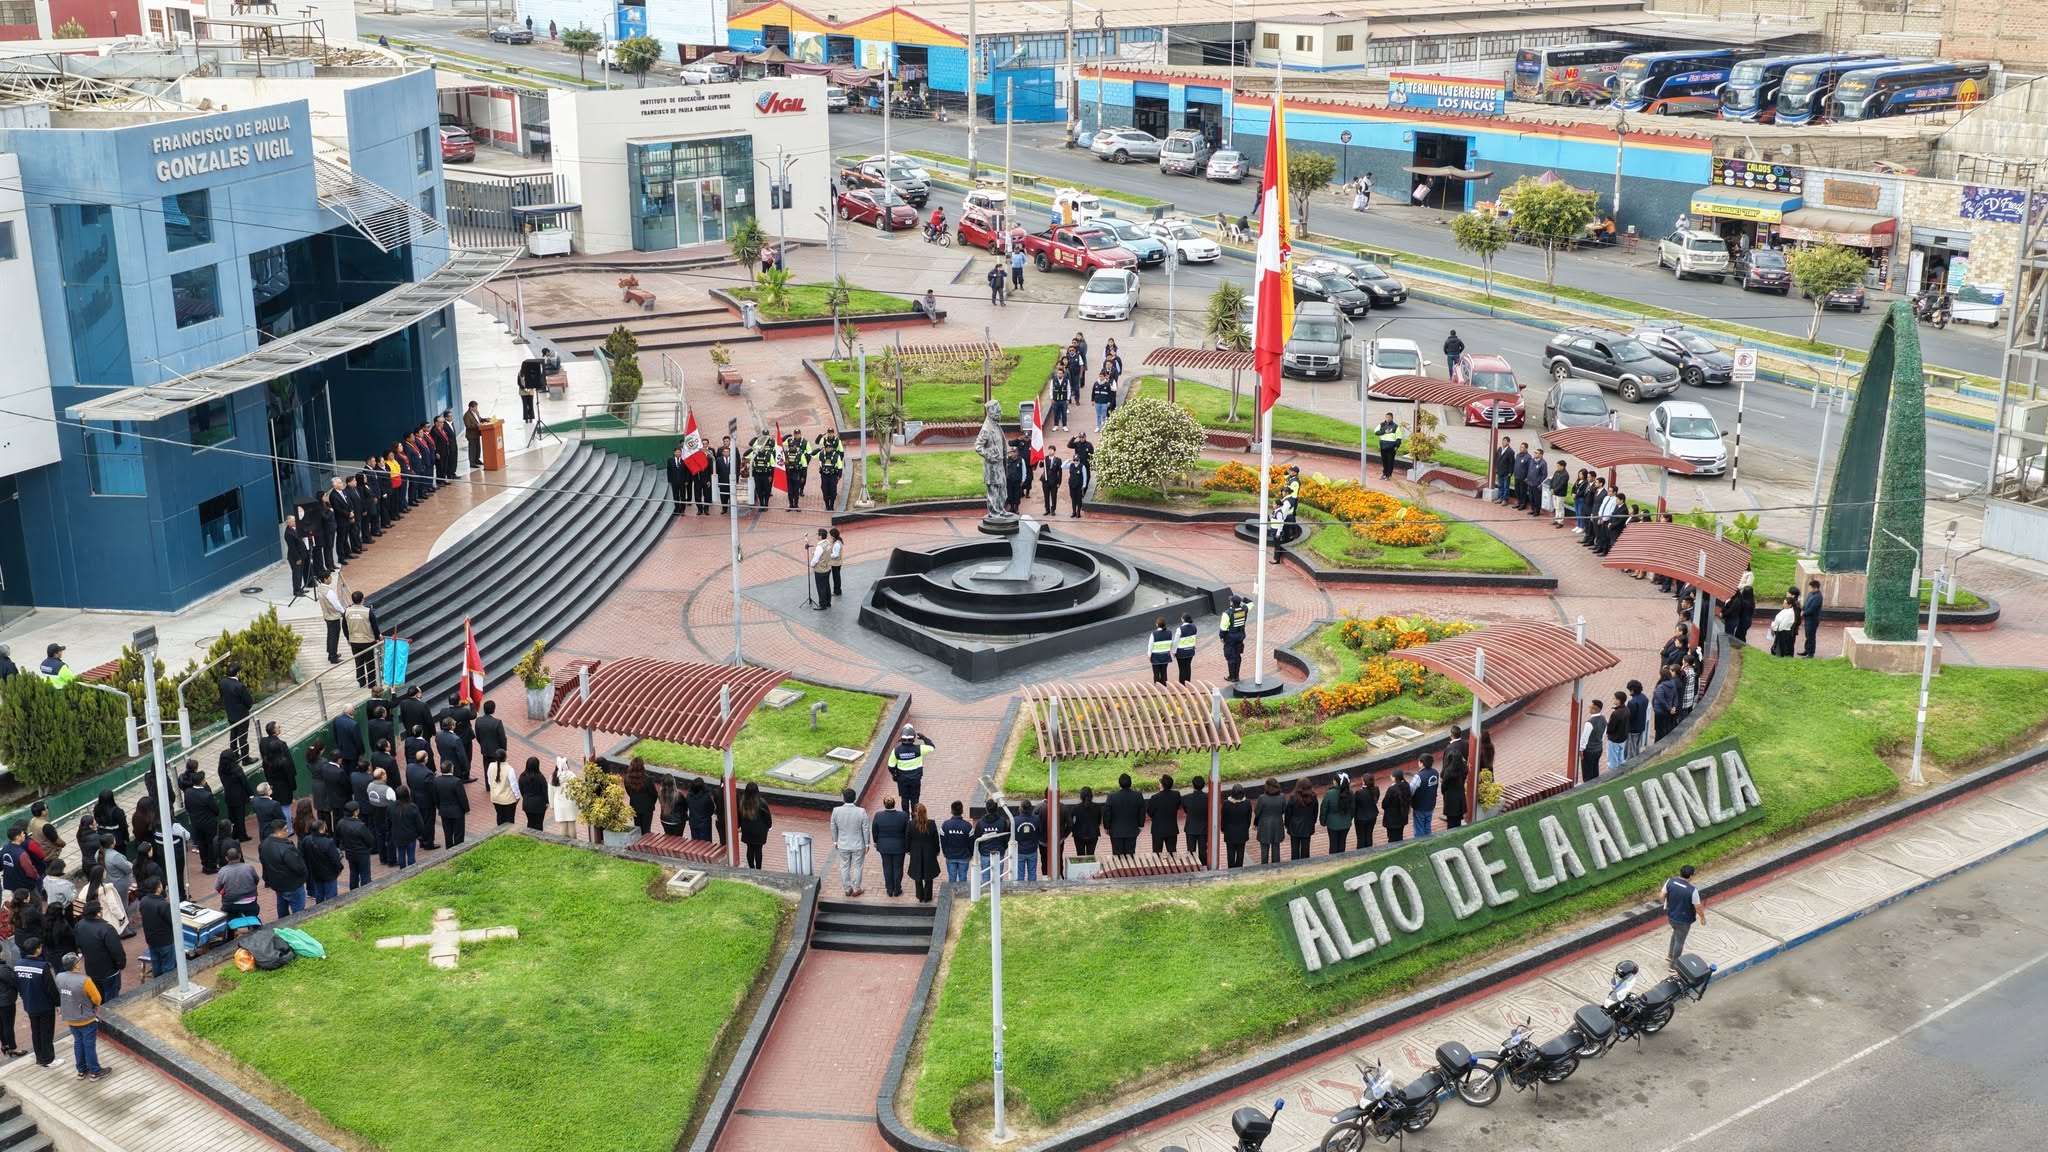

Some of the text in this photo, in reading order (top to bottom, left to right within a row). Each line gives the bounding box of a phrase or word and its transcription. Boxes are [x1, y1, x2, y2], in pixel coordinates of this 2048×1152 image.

[1409, 82, 1496, 99] TERMINAL TERRESTRE
[756, 92, 807, 114] VIGIL
[1437, 97, 1495, 111] LOS INCAS
[152, 115, 291, 154] FRANCISCO DE PAULA
[156, 137, 294, 182] GONZALES VIGIL
[1747, 163, 1771, 173] CALDOS
[1288, 749, 1762, 972] ALTO DE LA ALIANZA
